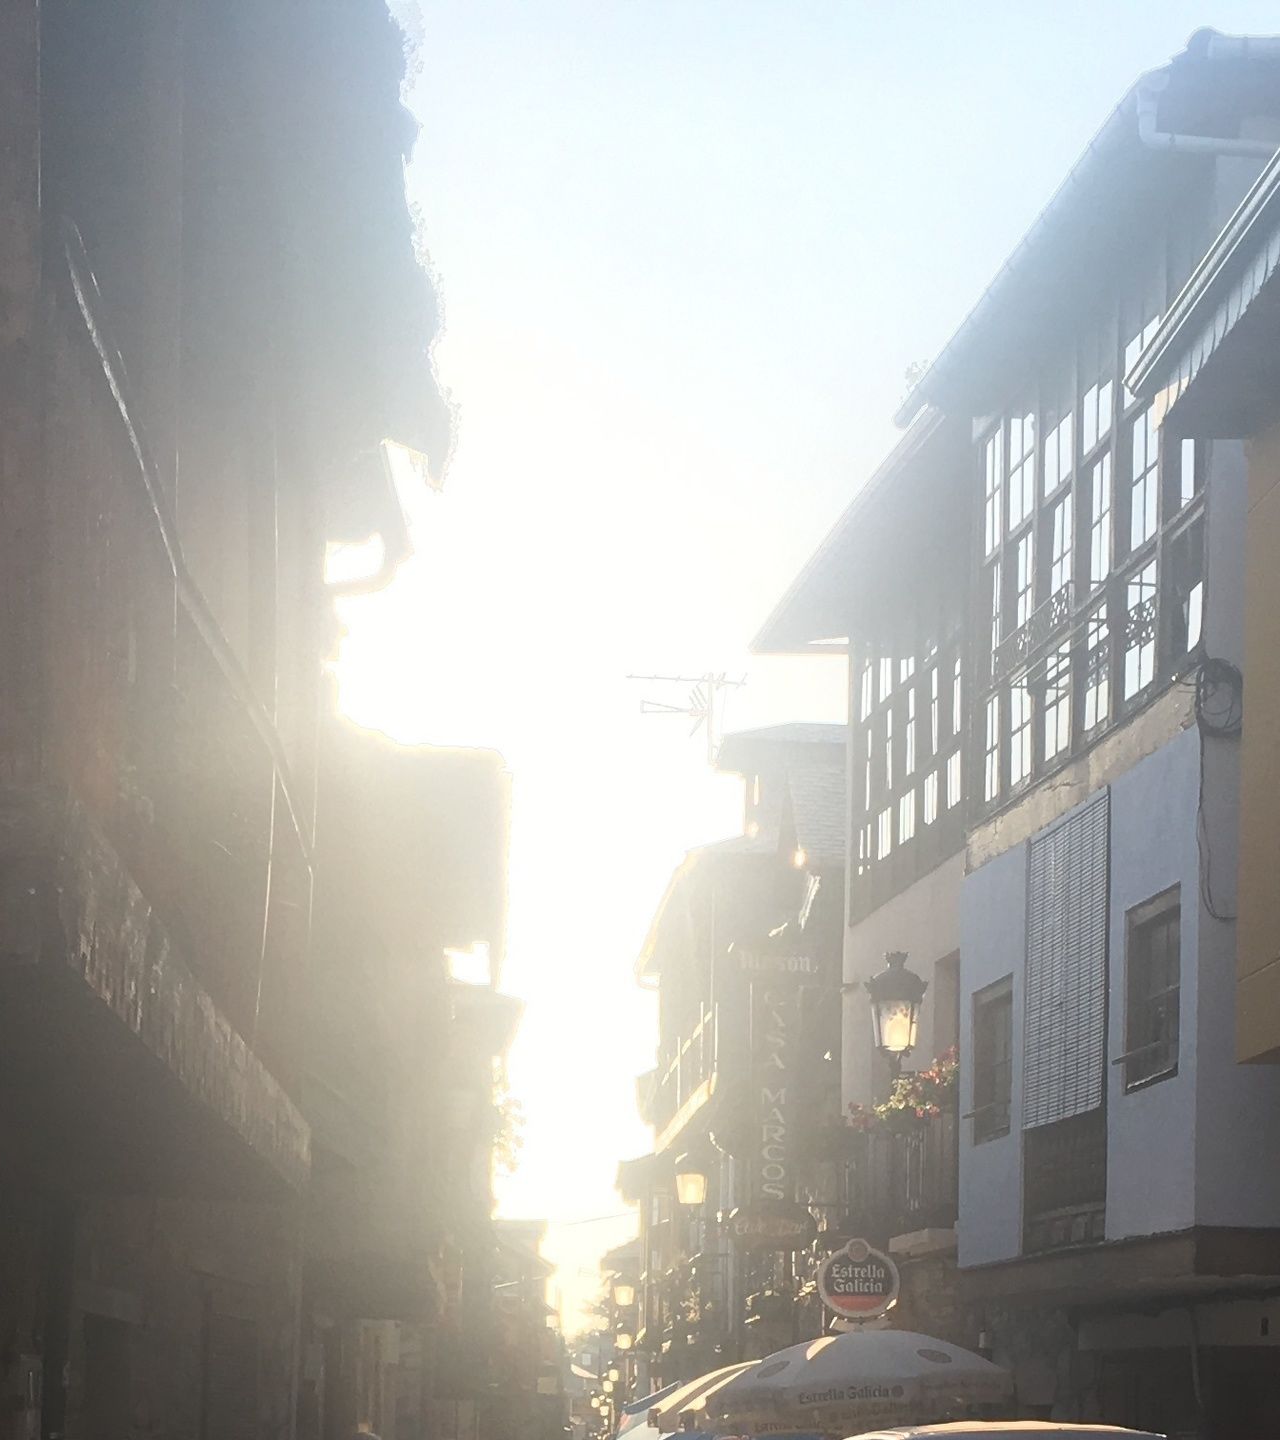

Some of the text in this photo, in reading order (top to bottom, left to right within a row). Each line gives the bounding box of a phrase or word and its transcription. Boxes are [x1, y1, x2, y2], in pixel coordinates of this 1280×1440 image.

[759, 1087, 787, 1201] MARCOS
[830, 1263, 885, 1278] Estrella
[833, 1279, 883, 1294] Galicia
[799, 1385, 890, 1405] Estrella Galicia
